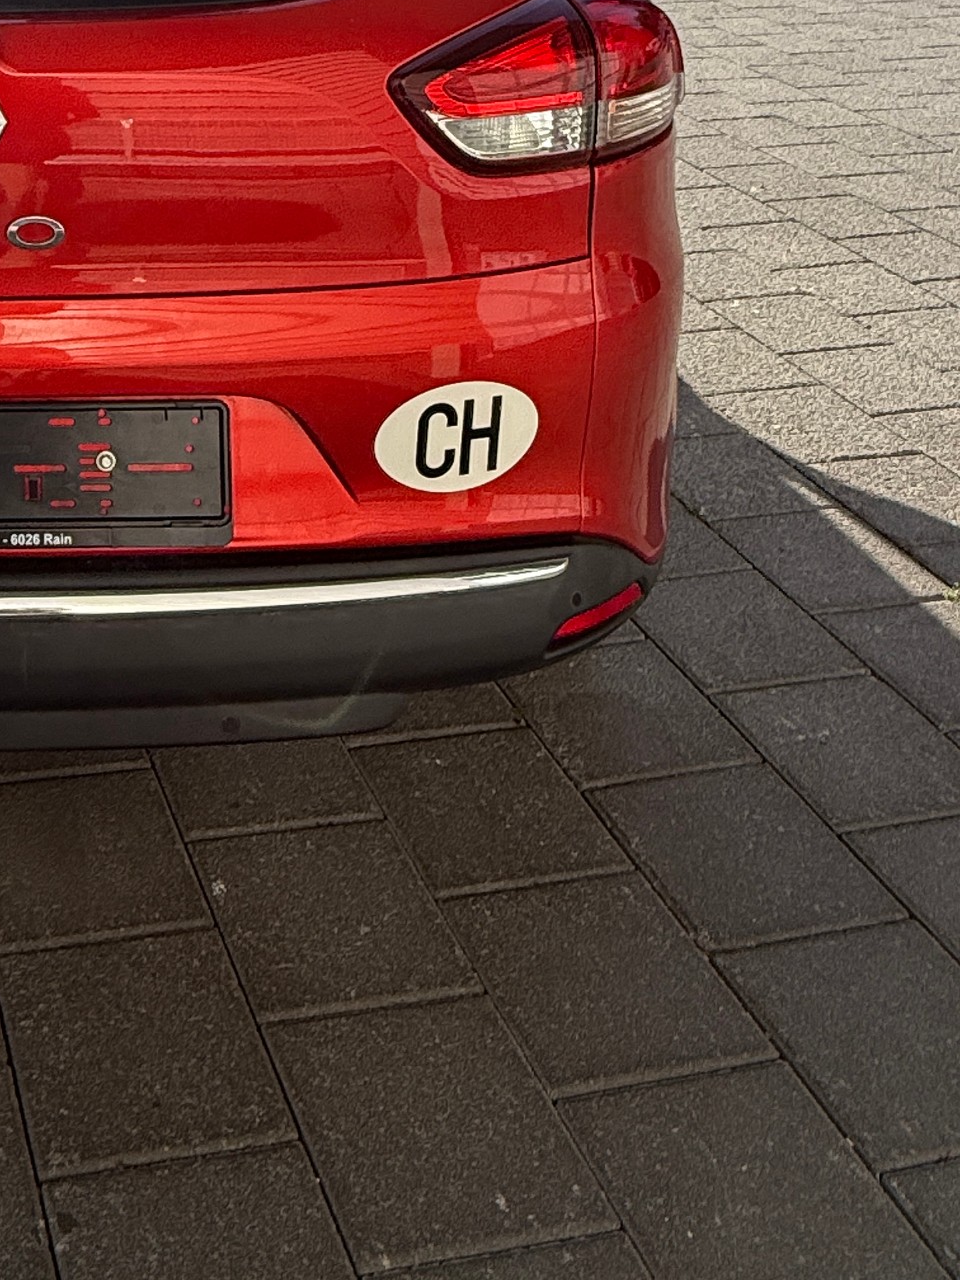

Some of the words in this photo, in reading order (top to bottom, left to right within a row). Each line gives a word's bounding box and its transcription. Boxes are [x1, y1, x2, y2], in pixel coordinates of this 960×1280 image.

[415, 395, 503, 479] CH
[10, 533, 41, 546] 6026
[43, 533, 73, 545] Rain
